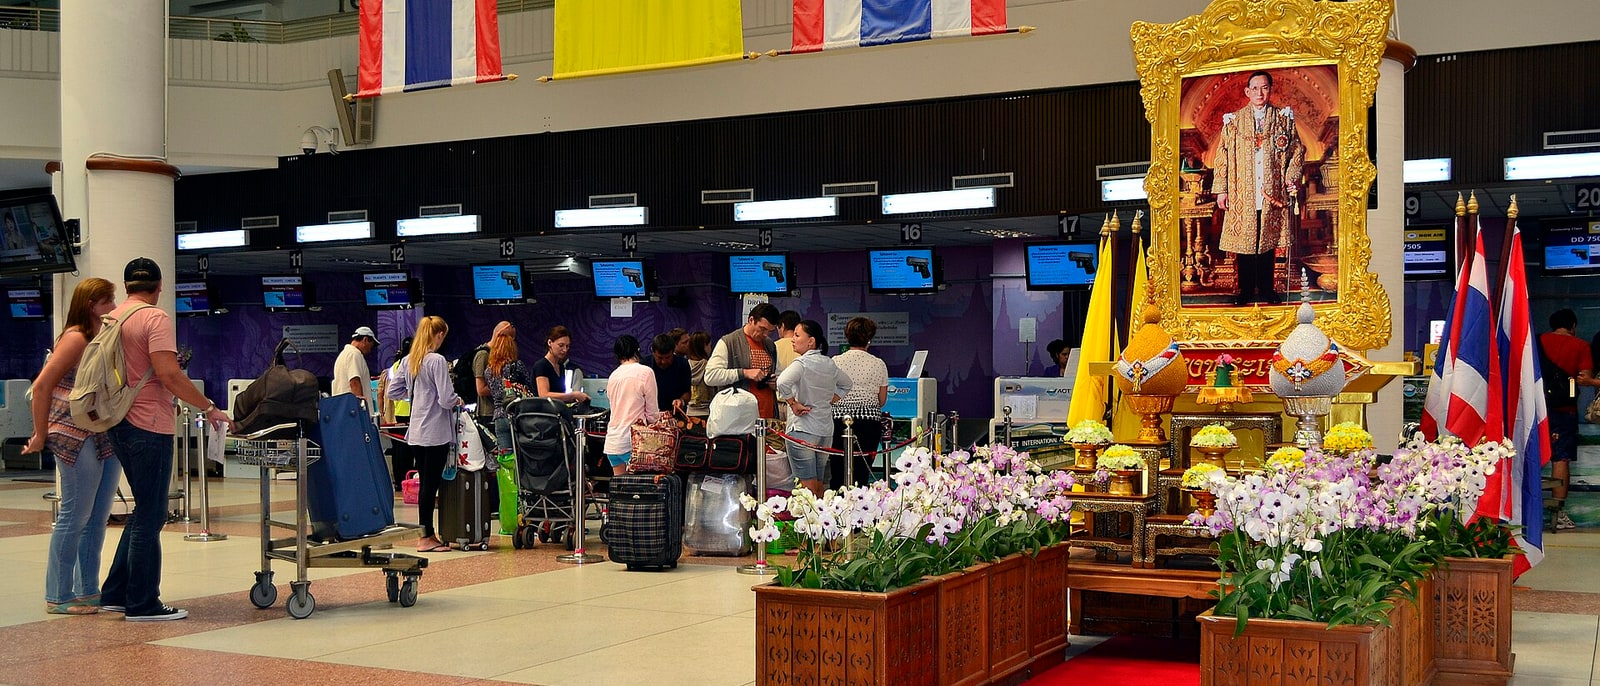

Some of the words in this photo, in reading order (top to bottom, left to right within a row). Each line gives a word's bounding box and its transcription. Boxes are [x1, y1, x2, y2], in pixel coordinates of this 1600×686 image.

[1577, 187, 1600, 207] 20
[1405, 196, 1420, 215] 9
[902, 223, 921, 241] 16
[1060, 215, 1079, 233] 17
[623, 234, 637, 249] 14
[759, 230, 772, 246] 15
[391, 247, 404, 262] 12
[500, 240, 514, 256] 13
[198, 257, 208, 270] 10
[290, 253, 302, 267] 11
